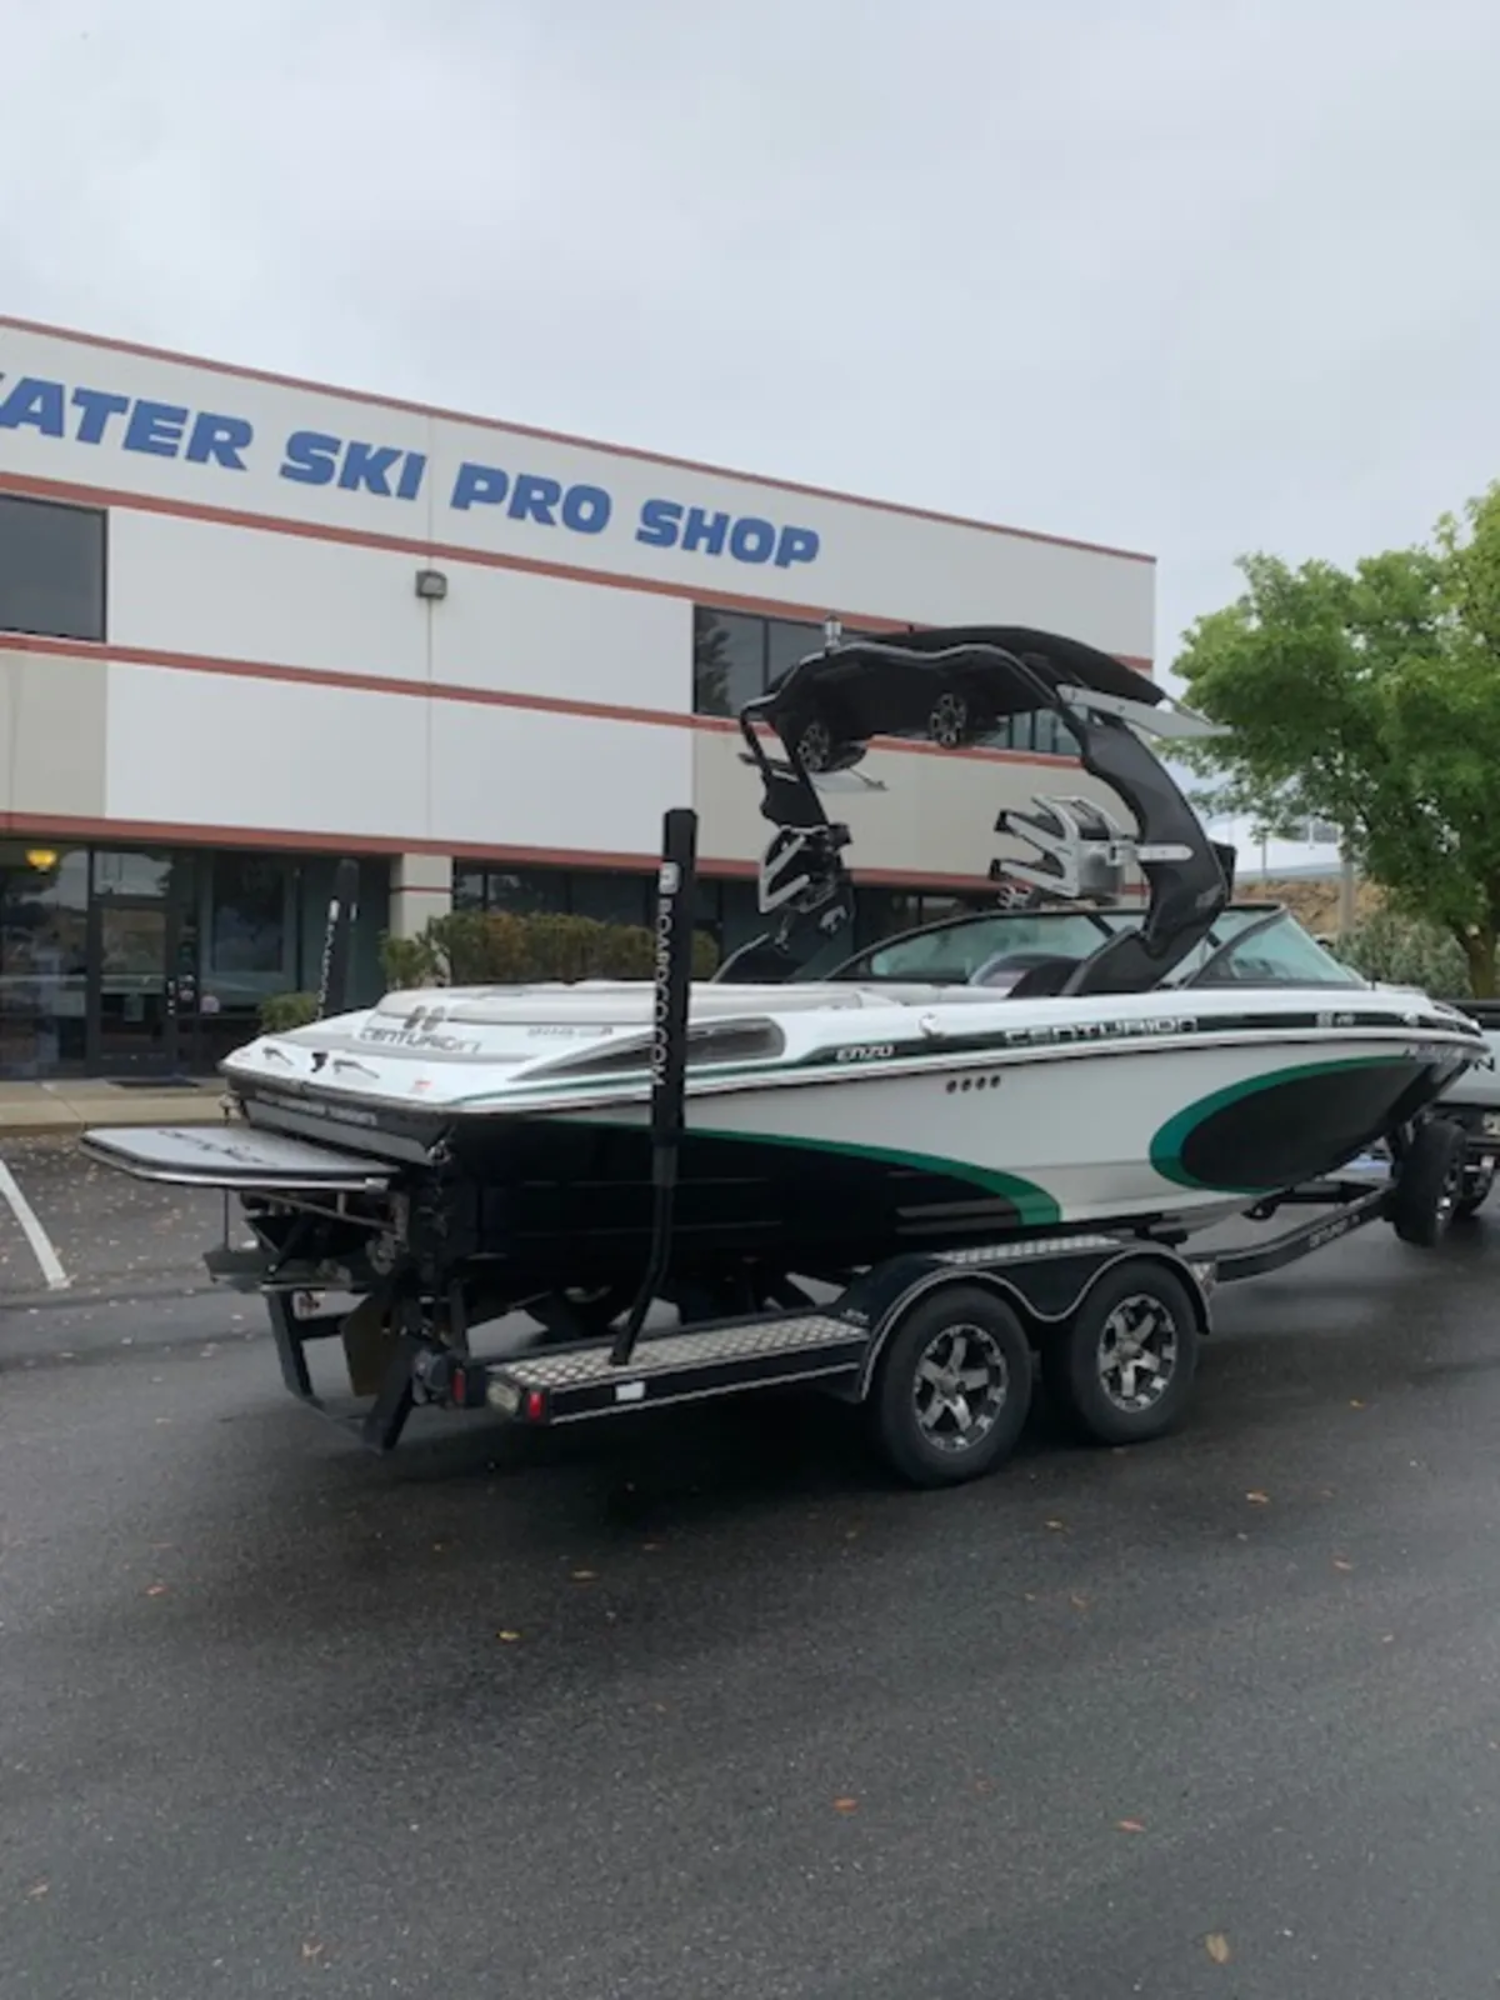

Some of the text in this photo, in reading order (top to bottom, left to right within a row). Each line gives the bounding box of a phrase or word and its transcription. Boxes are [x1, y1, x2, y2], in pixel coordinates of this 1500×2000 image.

[0, 372, 820, 569] ATER SKI PRO SHOP
